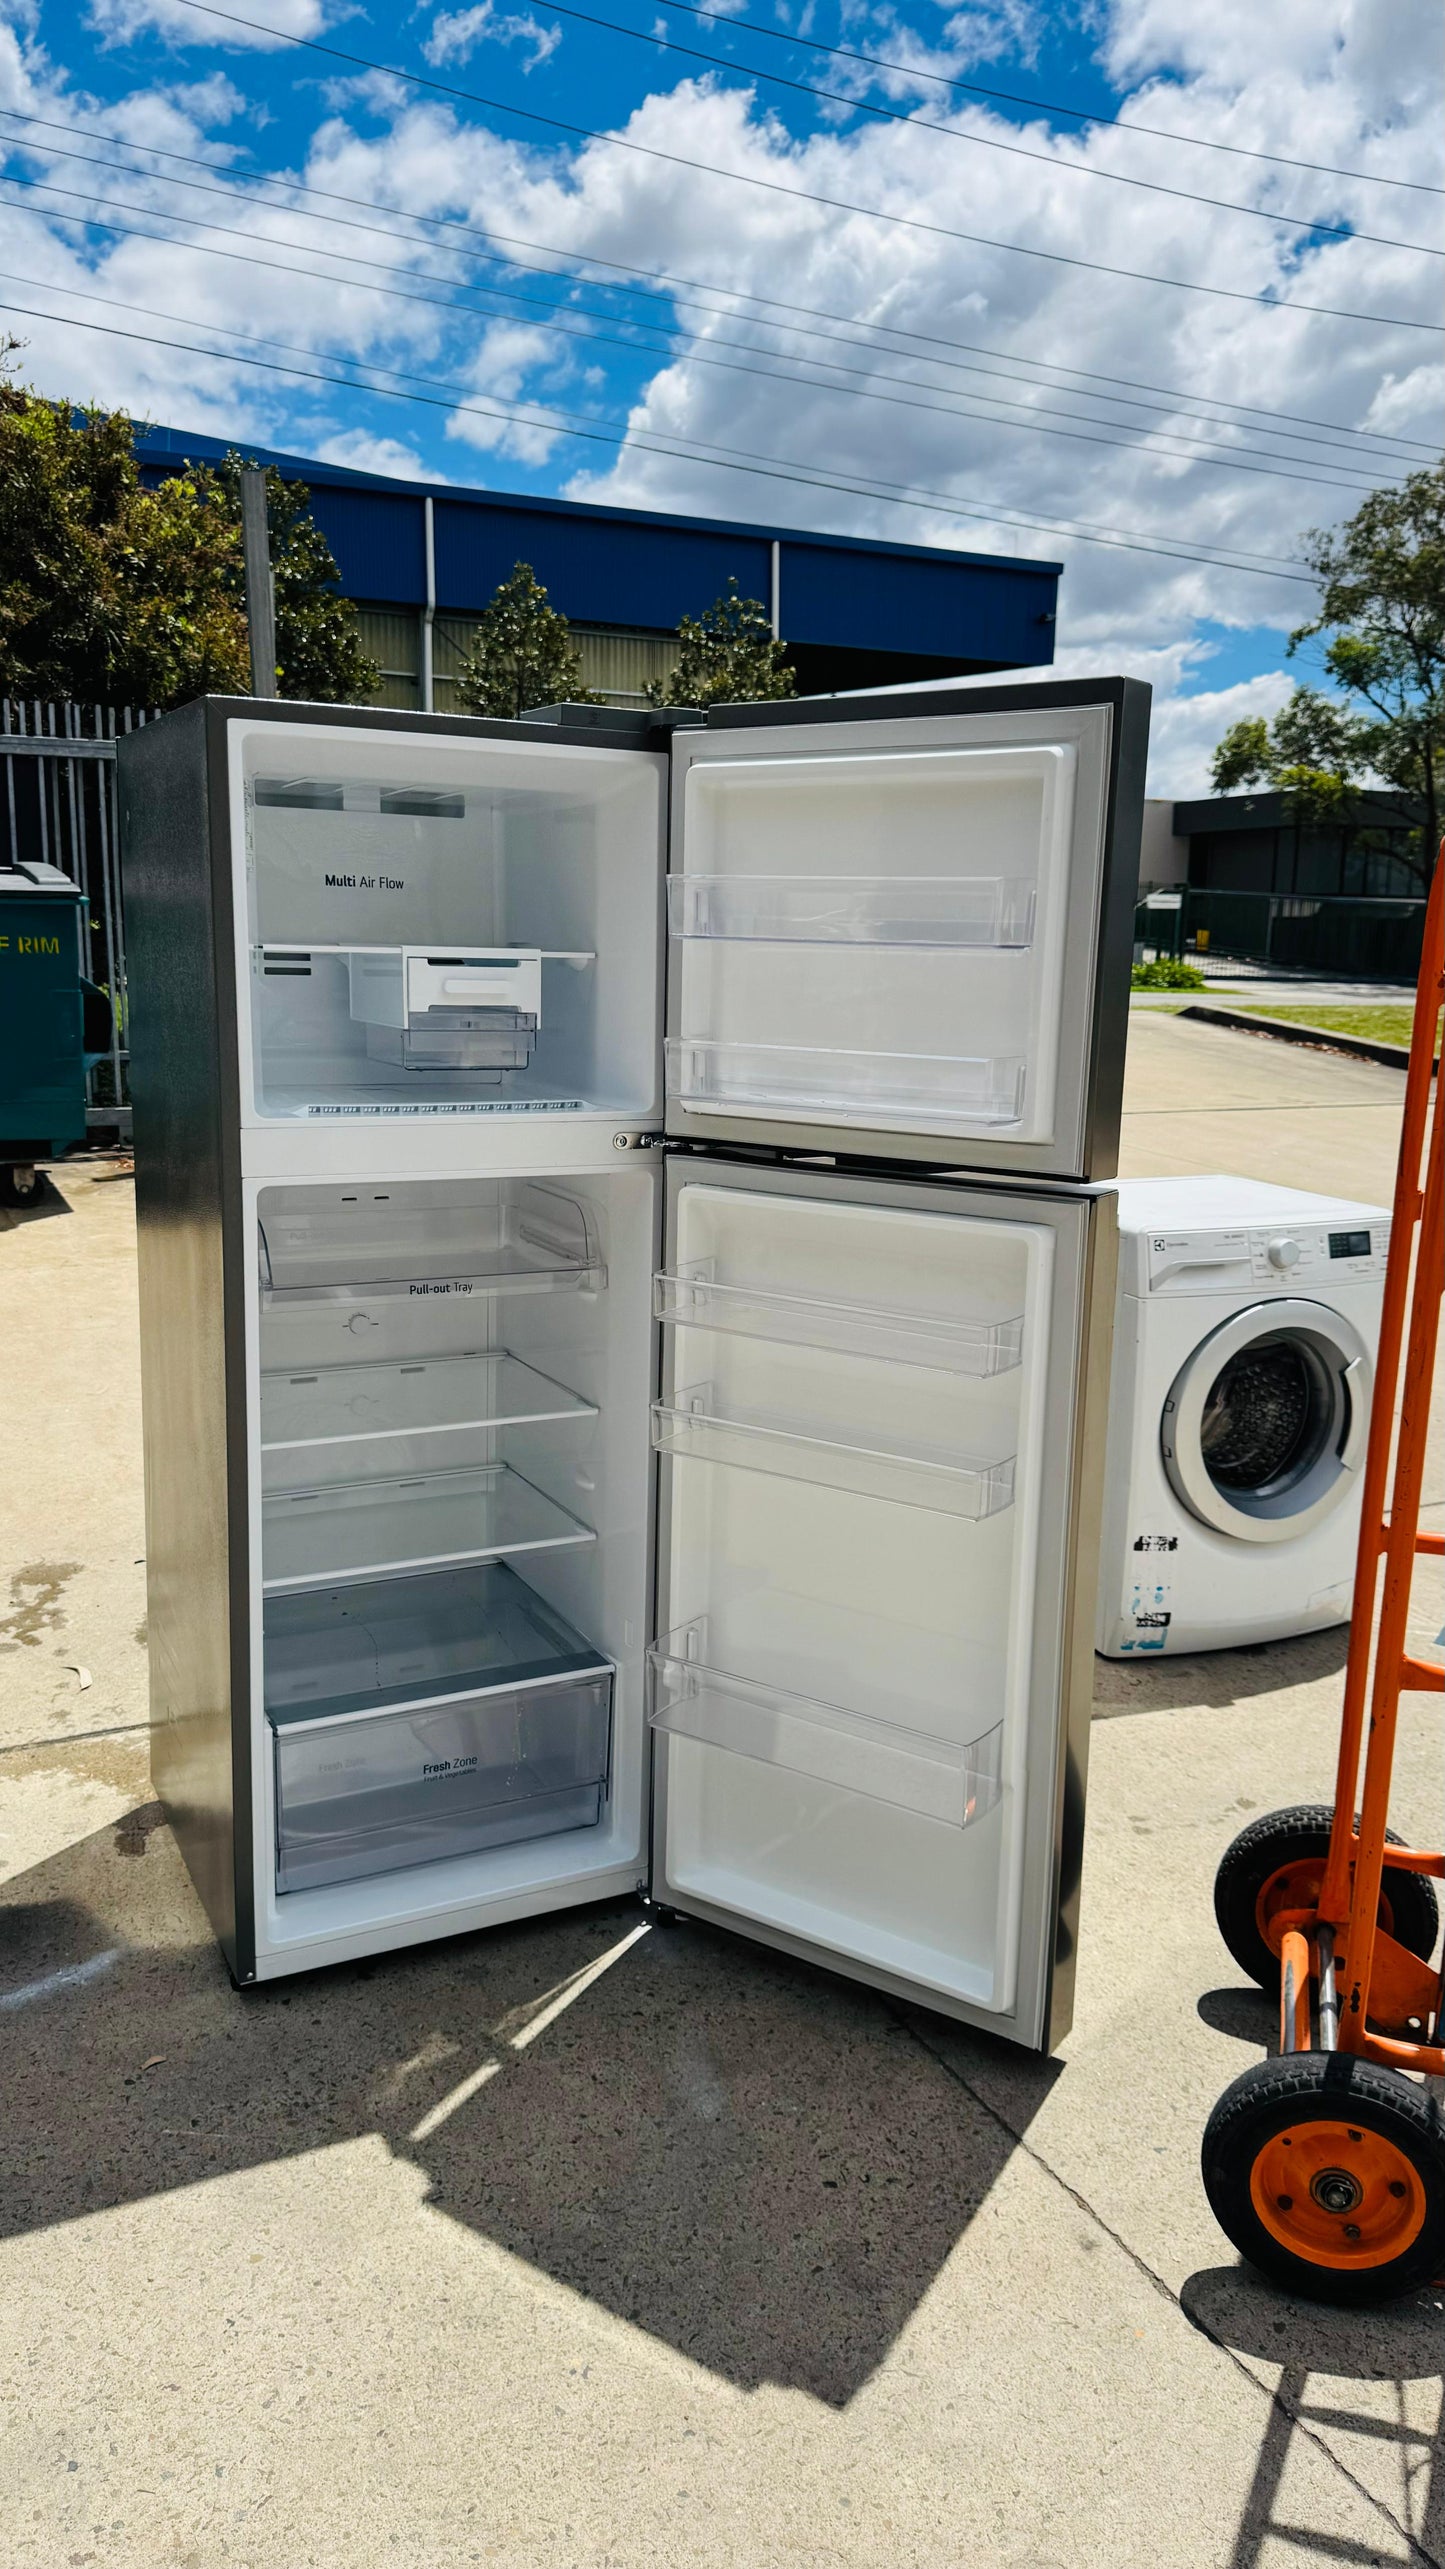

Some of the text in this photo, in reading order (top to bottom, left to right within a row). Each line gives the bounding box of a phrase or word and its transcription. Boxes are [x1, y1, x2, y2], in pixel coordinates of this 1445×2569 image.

[325, 874, 404, 889] Multi Air Flow
[18, 936, 60, 954] RIM
[409, 1282, 473, 1295] Pull-out Tray
[423, 1757, 478, 1774] Fresh Zone
